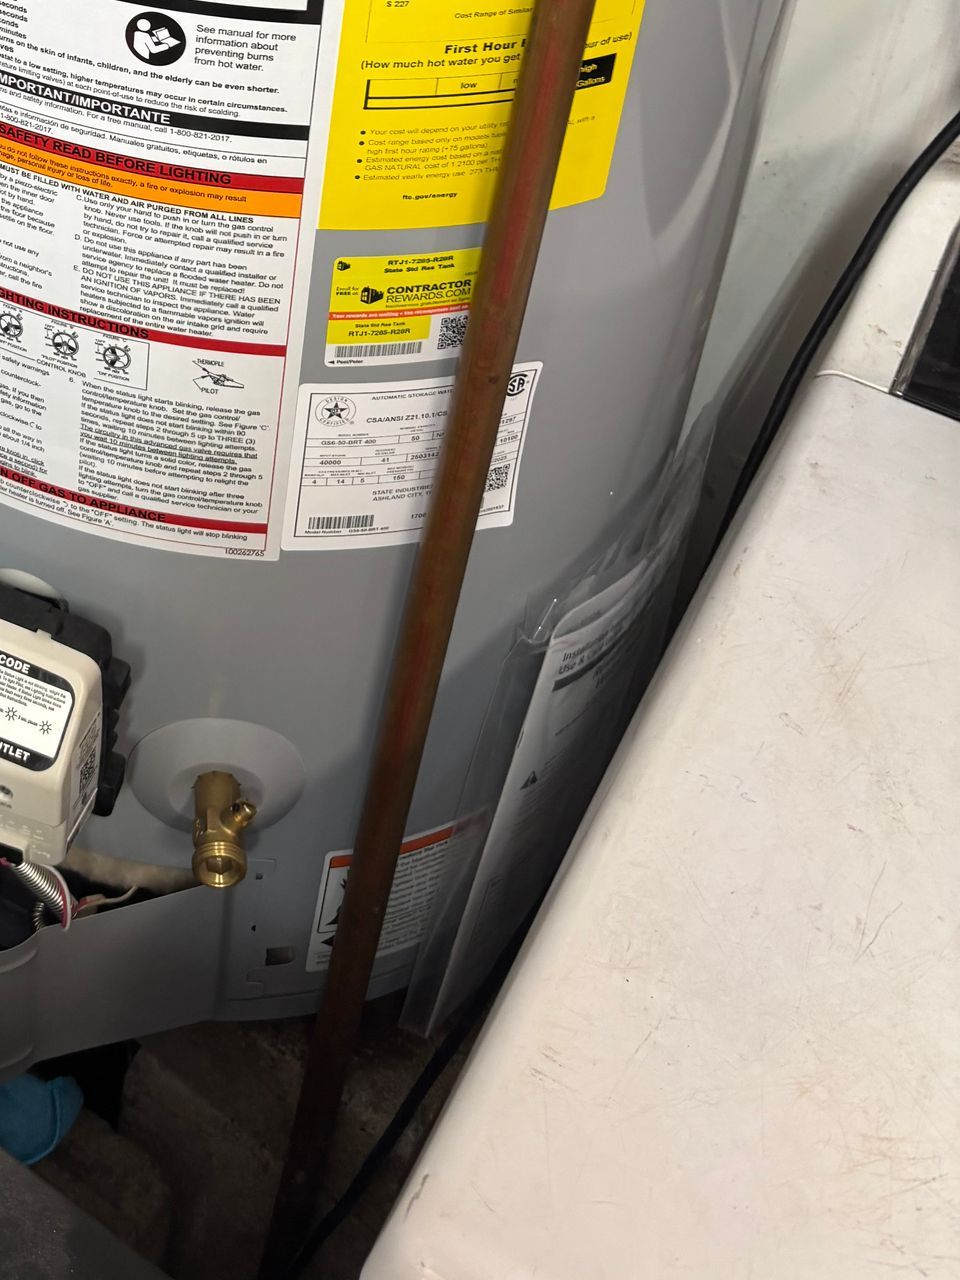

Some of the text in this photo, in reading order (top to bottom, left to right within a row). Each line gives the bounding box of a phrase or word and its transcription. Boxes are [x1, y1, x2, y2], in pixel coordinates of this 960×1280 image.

[196, 24, 297, 42] See manual for more
[195, 34, 279, 52] information about
[444, 43, 479, 55] First
[482, 41, 518, 52] Hour
[194, 47, 274, 62] preventing burns
[360, 52, 521, 71] (How much hot water you get
[194, 55, 264, 72] from hot water.
[460, 81, 478, 90] low
[52, 139, 91, 159] READ
[95, 151, 155, 173] BEFORE
[160, 165, 232, 185] LIGHTING
[386, 278, 472, 295] CONTRACTOR
[385, 287, 472, 304] REWARDS.COM
[47, 306, 149, 339] INSTRUCTIONS
[12, 473, 36, 488] OFF
[38, 483, 66, 499] GAS
[68, 491, 87, 504] TO
[89, 499, 167, 522] APPLIANCE
